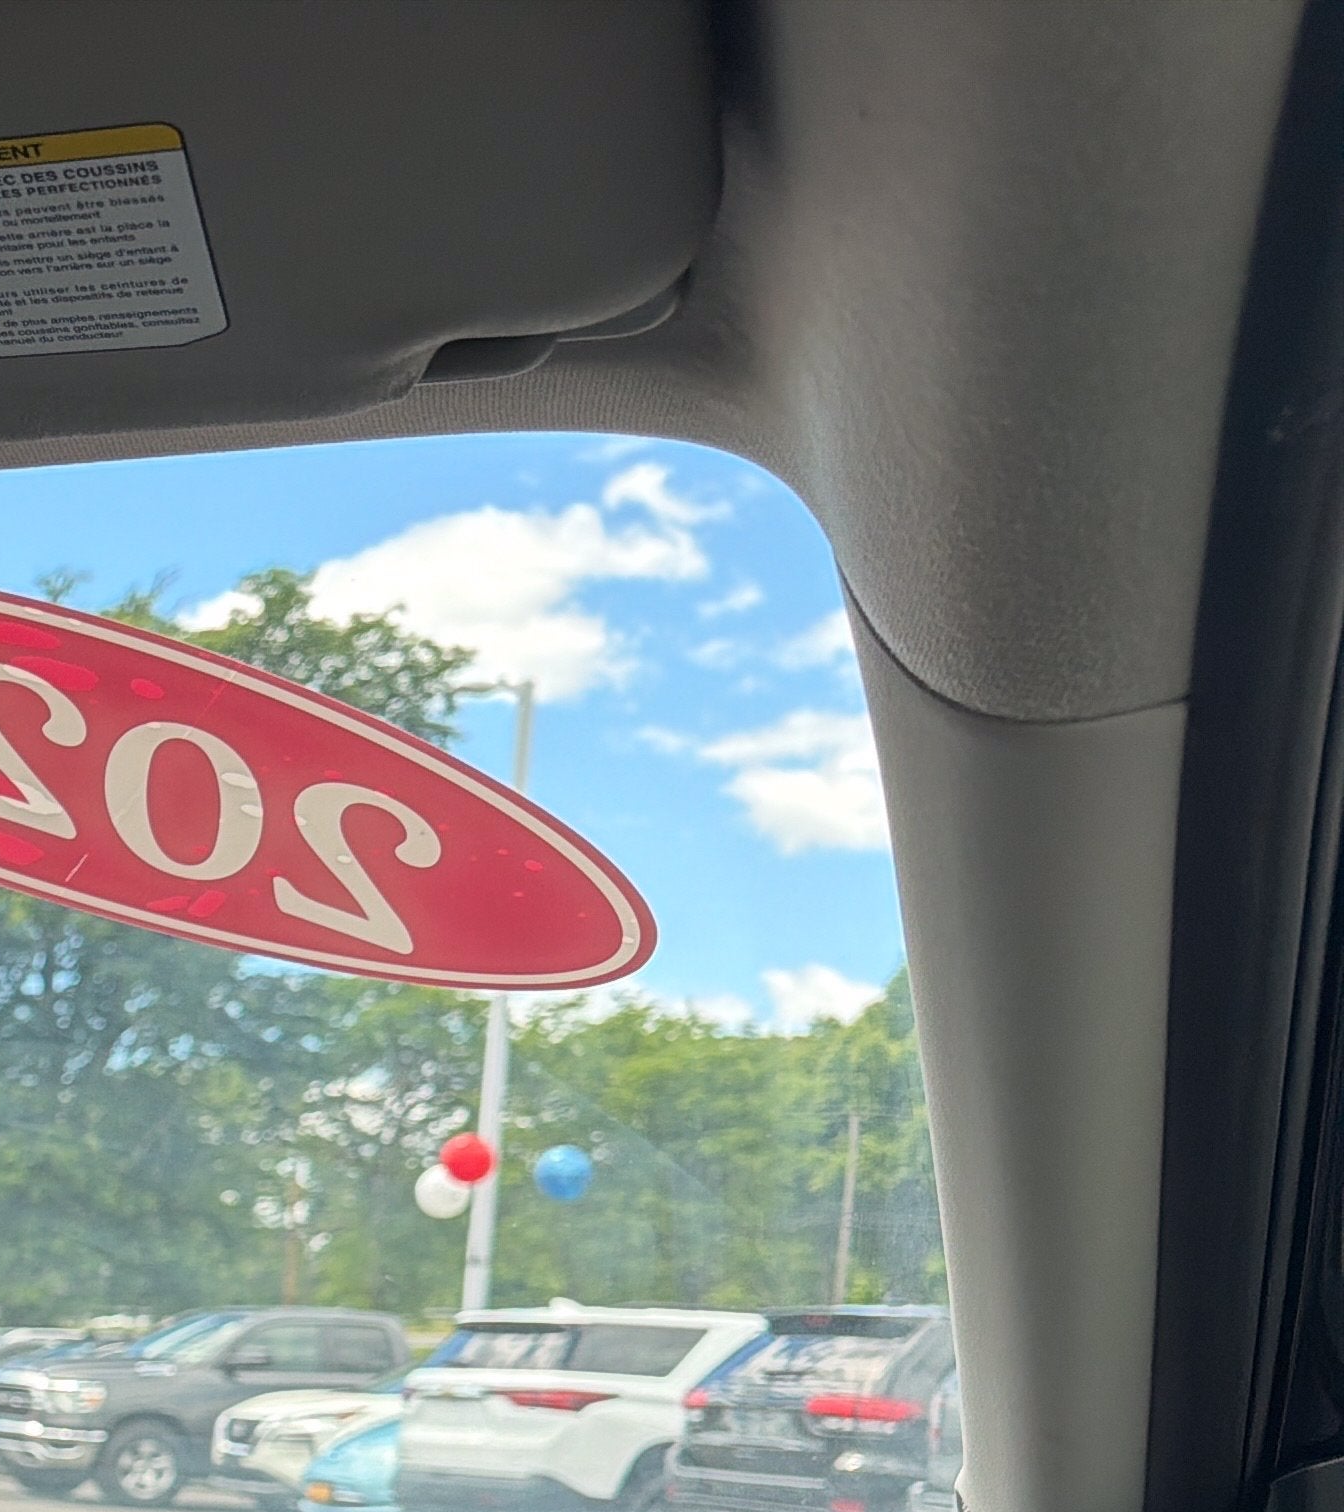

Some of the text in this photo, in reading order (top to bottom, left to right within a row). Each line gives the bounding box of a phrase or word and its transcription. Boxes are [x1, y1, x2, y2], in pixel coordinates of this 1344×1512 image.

[21, 172, 57, 184] DES
[63, 161, 158, 179] COUSSINS
[27, 175, 162, 195] PERFECTIONNÉS
